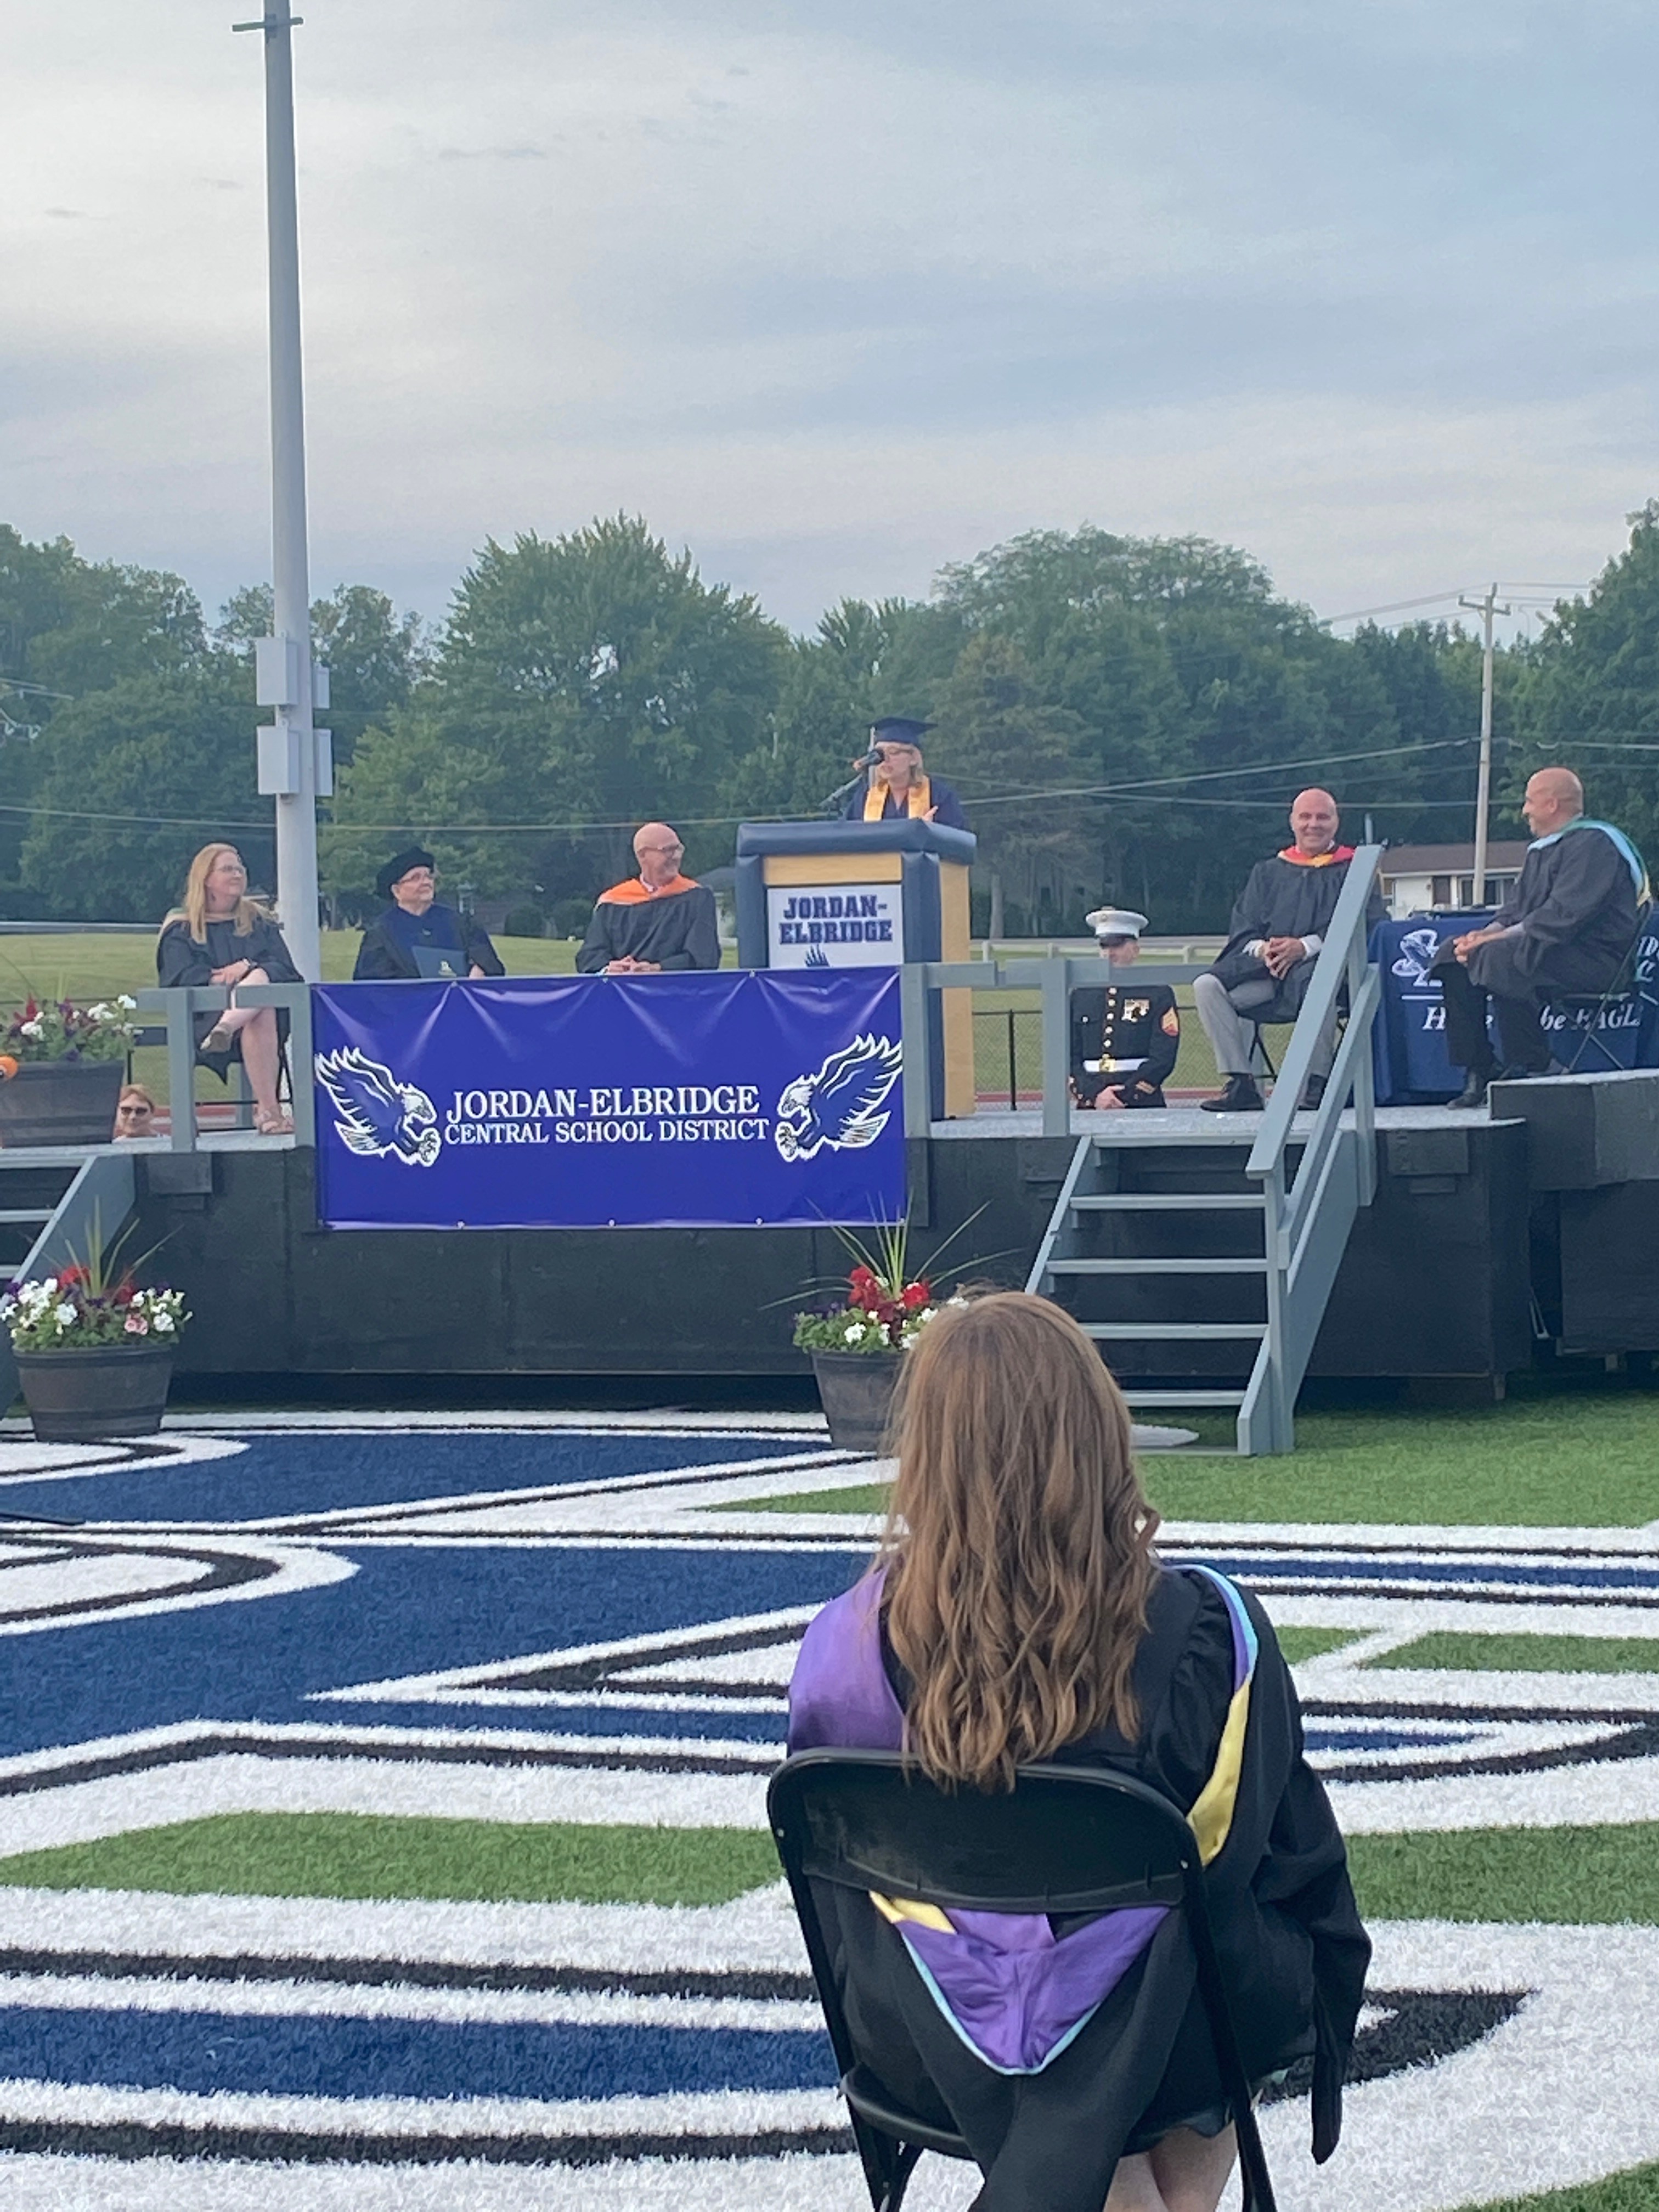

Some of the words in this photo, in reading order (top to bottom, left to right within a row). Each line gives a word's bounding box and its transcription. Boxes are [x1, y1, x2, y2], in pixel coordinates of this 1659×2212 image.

[783, 895, 888, 919] JORDAN-
[780, 920, 892, 944] ELBRIDGE
[447, 1086, 759, 1123] JORDAN-ELBRIDGE
[444, 1122, 549, 1144] CENTRAL
[555, 1120, 653, 1143] SCHOOL
[659, 1118, 769, 1141] DISTRICT
